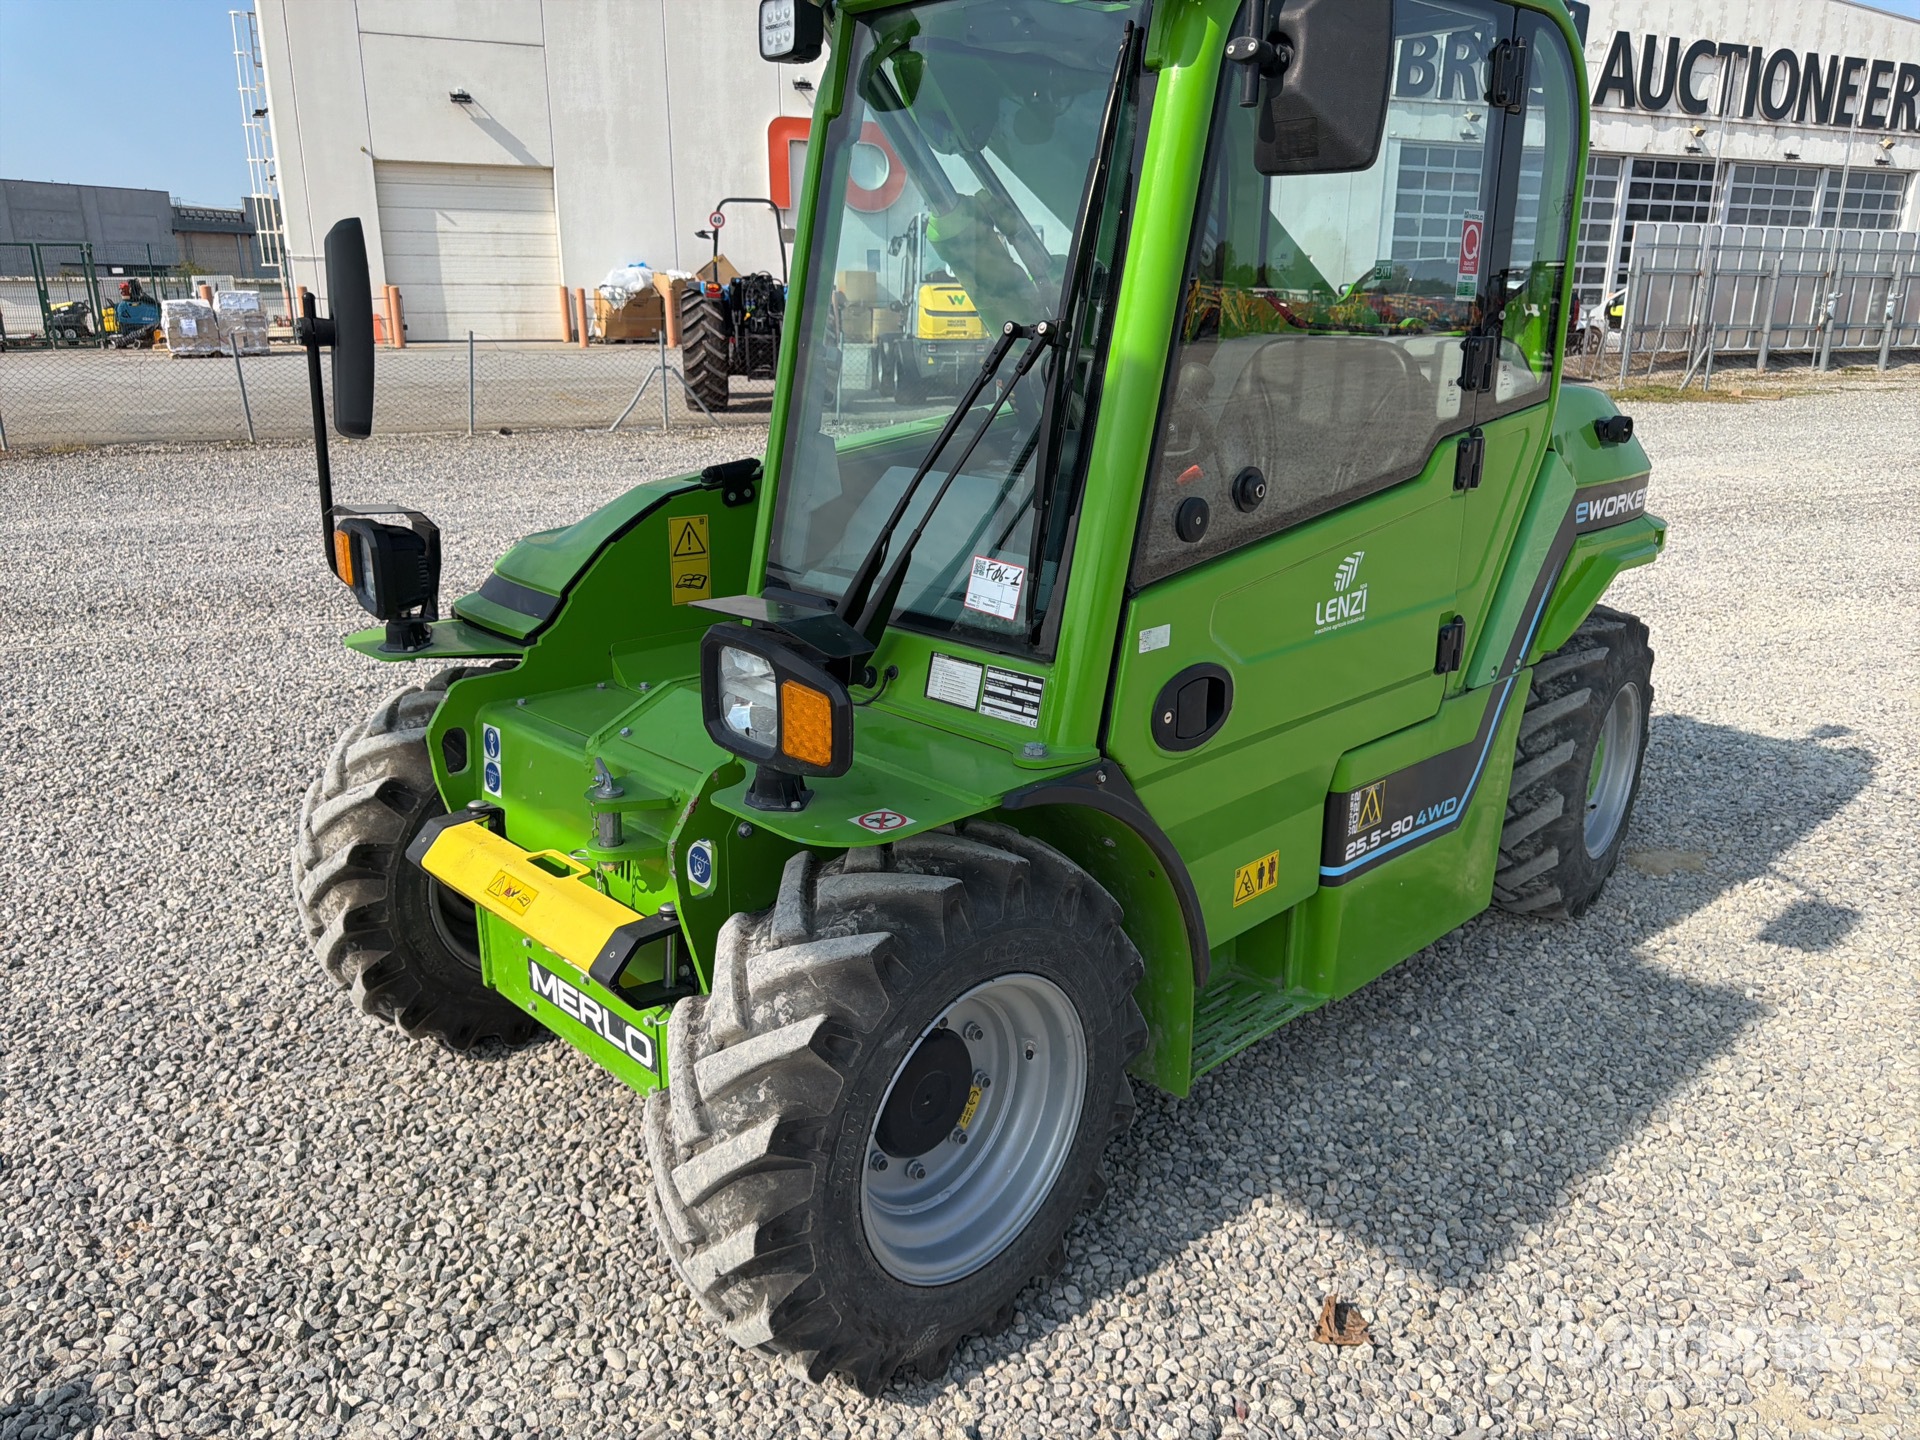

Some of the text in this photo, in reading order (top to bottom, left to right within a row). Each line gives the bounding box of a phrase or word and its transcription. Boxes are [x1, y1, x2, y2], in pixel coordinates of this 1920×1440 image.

[1591, 30, 1920, 131] AUCTIONEER
[1463, 224, 1479, 260] Q
[1376, 265, 1392, 277] EXIT
[1315, 589, 1368, 626] LENZI
[1344, 796, 1457, 862] 25.5-90 4WD
[1352, 790, 1361, 835] 2022
[530, 961, 654, 1068] MERLO
